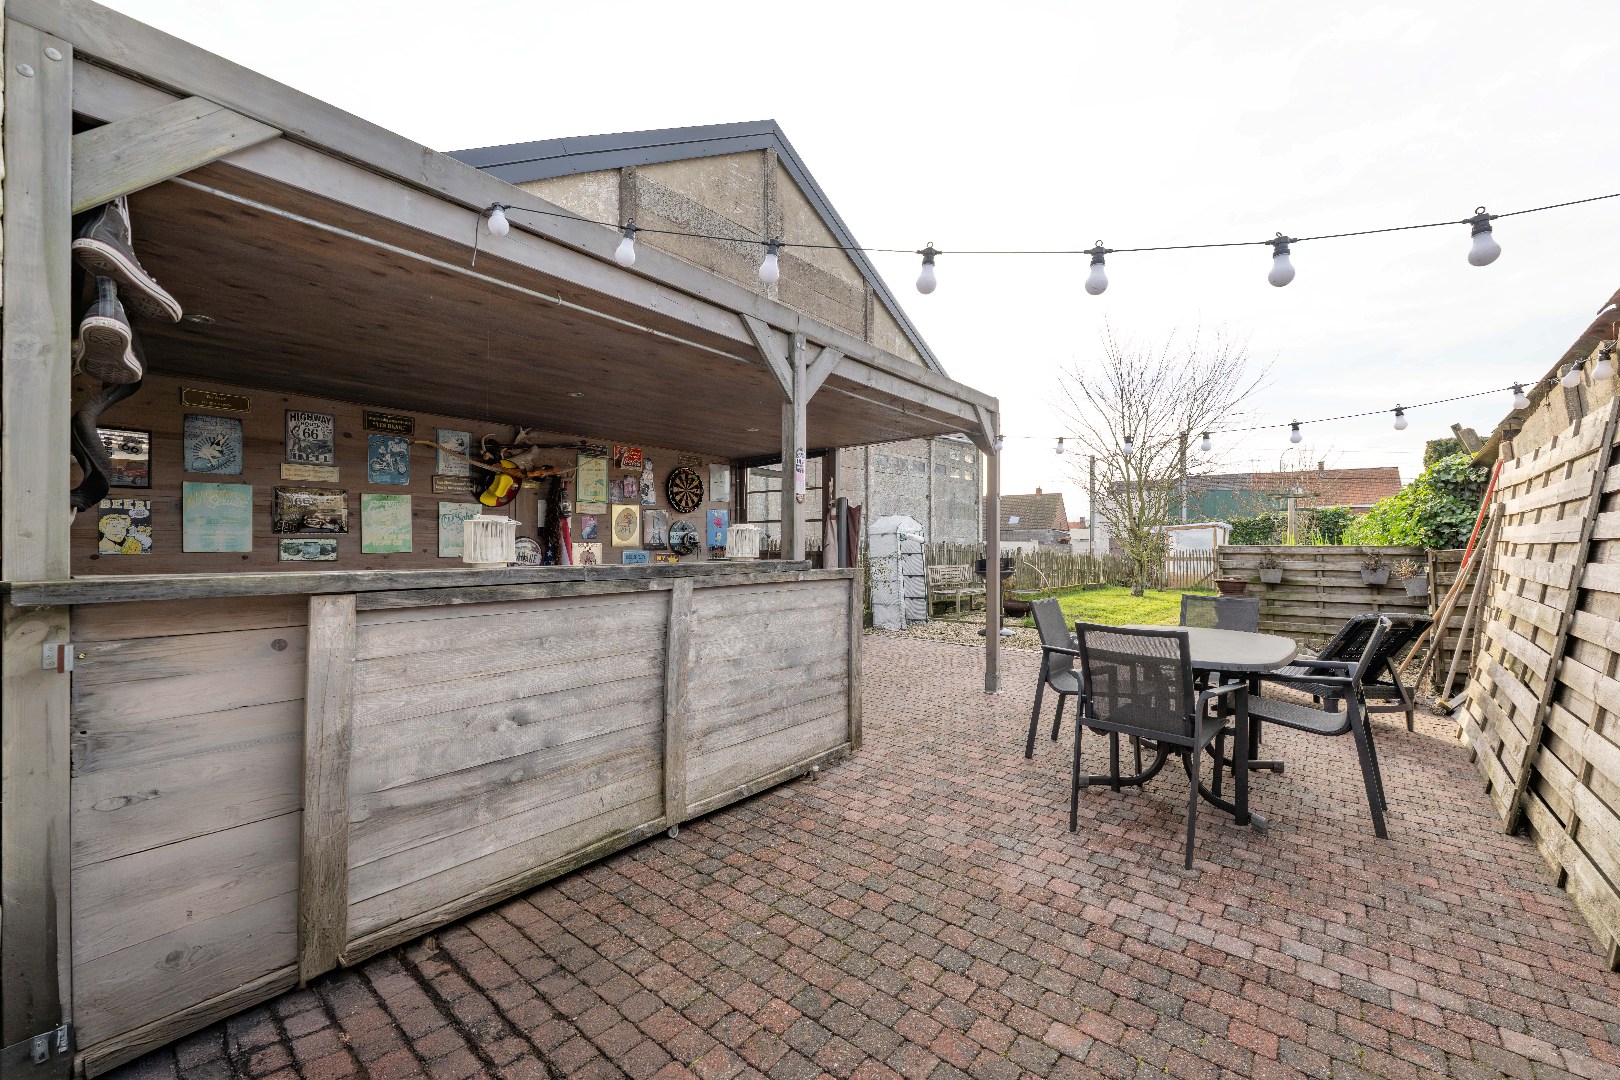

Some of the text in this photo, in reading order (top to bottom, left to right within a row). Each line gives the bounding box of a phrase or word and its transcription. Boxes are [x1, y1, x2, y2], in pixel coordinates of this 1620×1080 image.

[290, 412, 332, 426] HIGHWAY
[302, 428, 319, 440] 66
[121, 442, 140, 454] 66
[99, 498, 152, 510] BEER!
